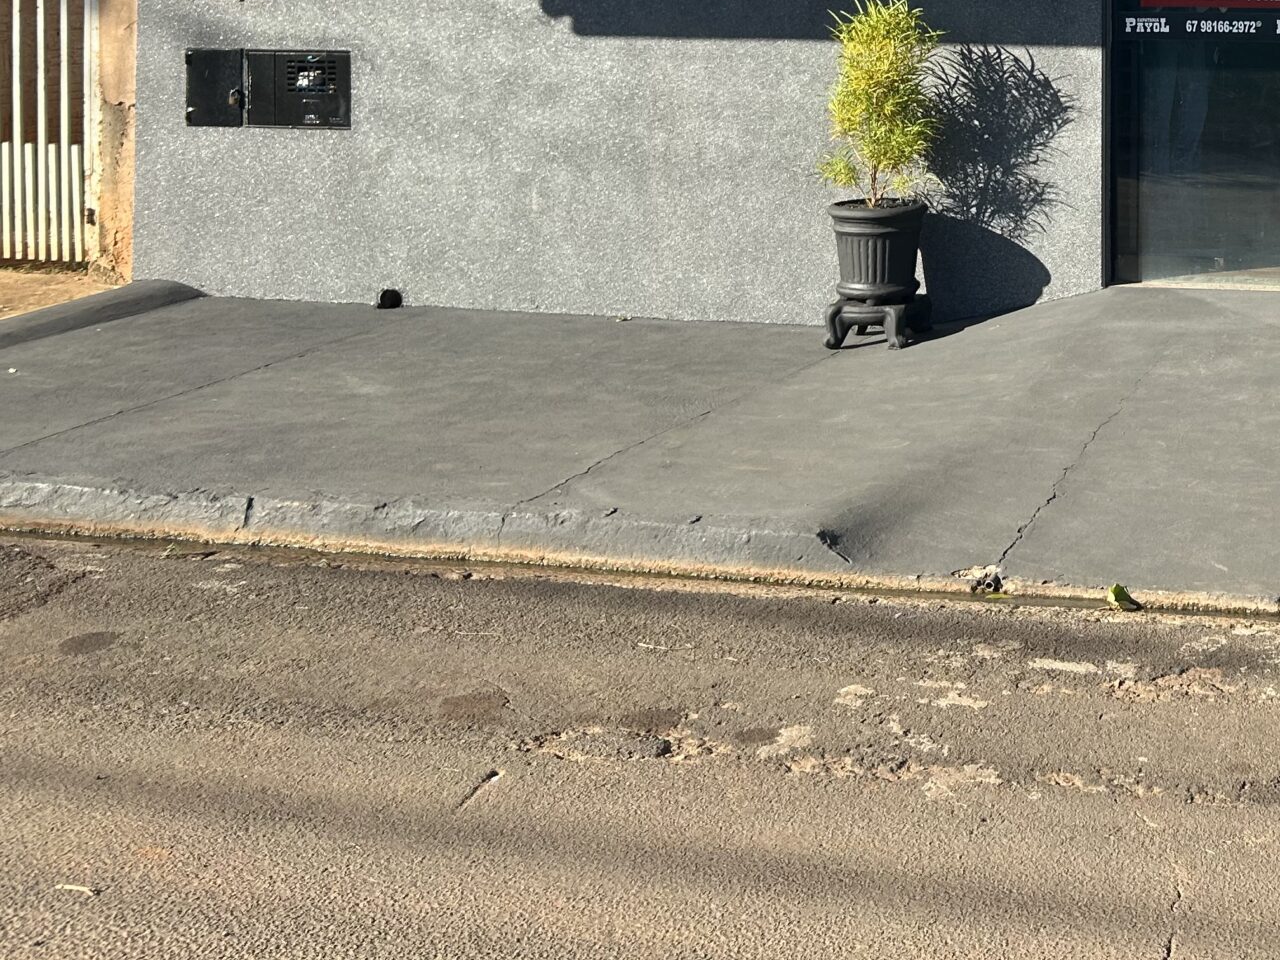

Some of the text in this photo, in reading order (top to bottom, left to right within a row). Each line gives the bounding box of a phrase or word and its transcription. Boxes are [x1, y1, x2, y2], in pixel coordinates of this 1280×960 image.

[1125, 17, 1170, 33] PAYOL
[1185, 20, 1198, 33] 67
[1200, 20, 1256, 33] 98166-2972
